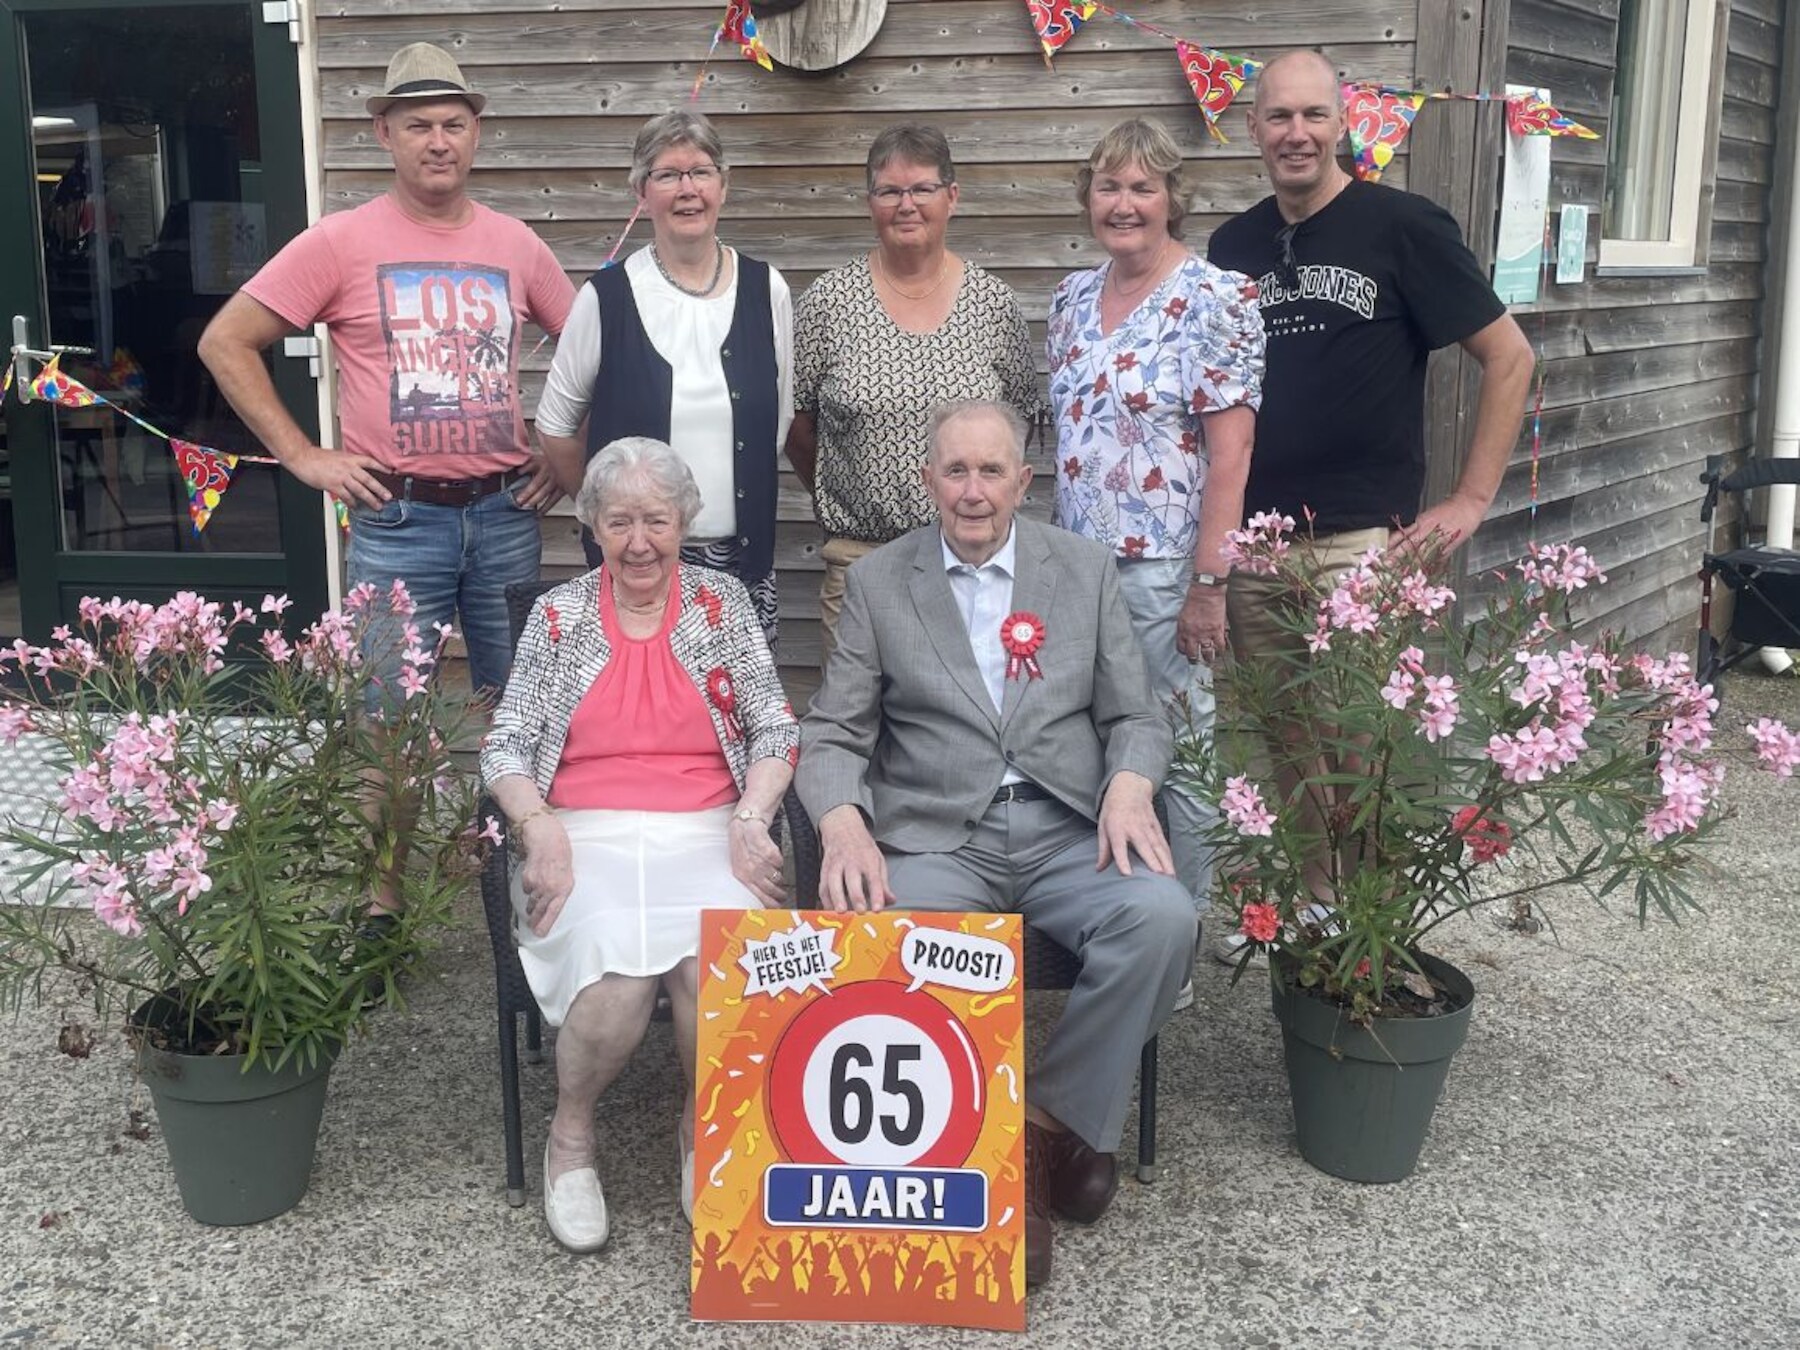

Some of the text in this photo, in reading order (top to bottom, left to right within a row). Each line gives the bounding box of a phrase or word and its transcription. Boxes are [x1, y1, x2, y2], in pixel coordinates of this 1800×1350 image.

[1184, 51, 1247, 115] 65
[1347, 90, 1419, 148] 65
[382, 274, 498, 332] LOS
[391, 419, 490, 457] SURF
[176, 447, 236, 494] 65
[753, 935, 821, 963] HIER IS HET
[756, 951, 827, 987] FEESTJE!
[912, 938, 1003, 981] PROOST!
[828, 1042, 925, 1147] 65
[803, 1174, 946, 1221] JAAR!
